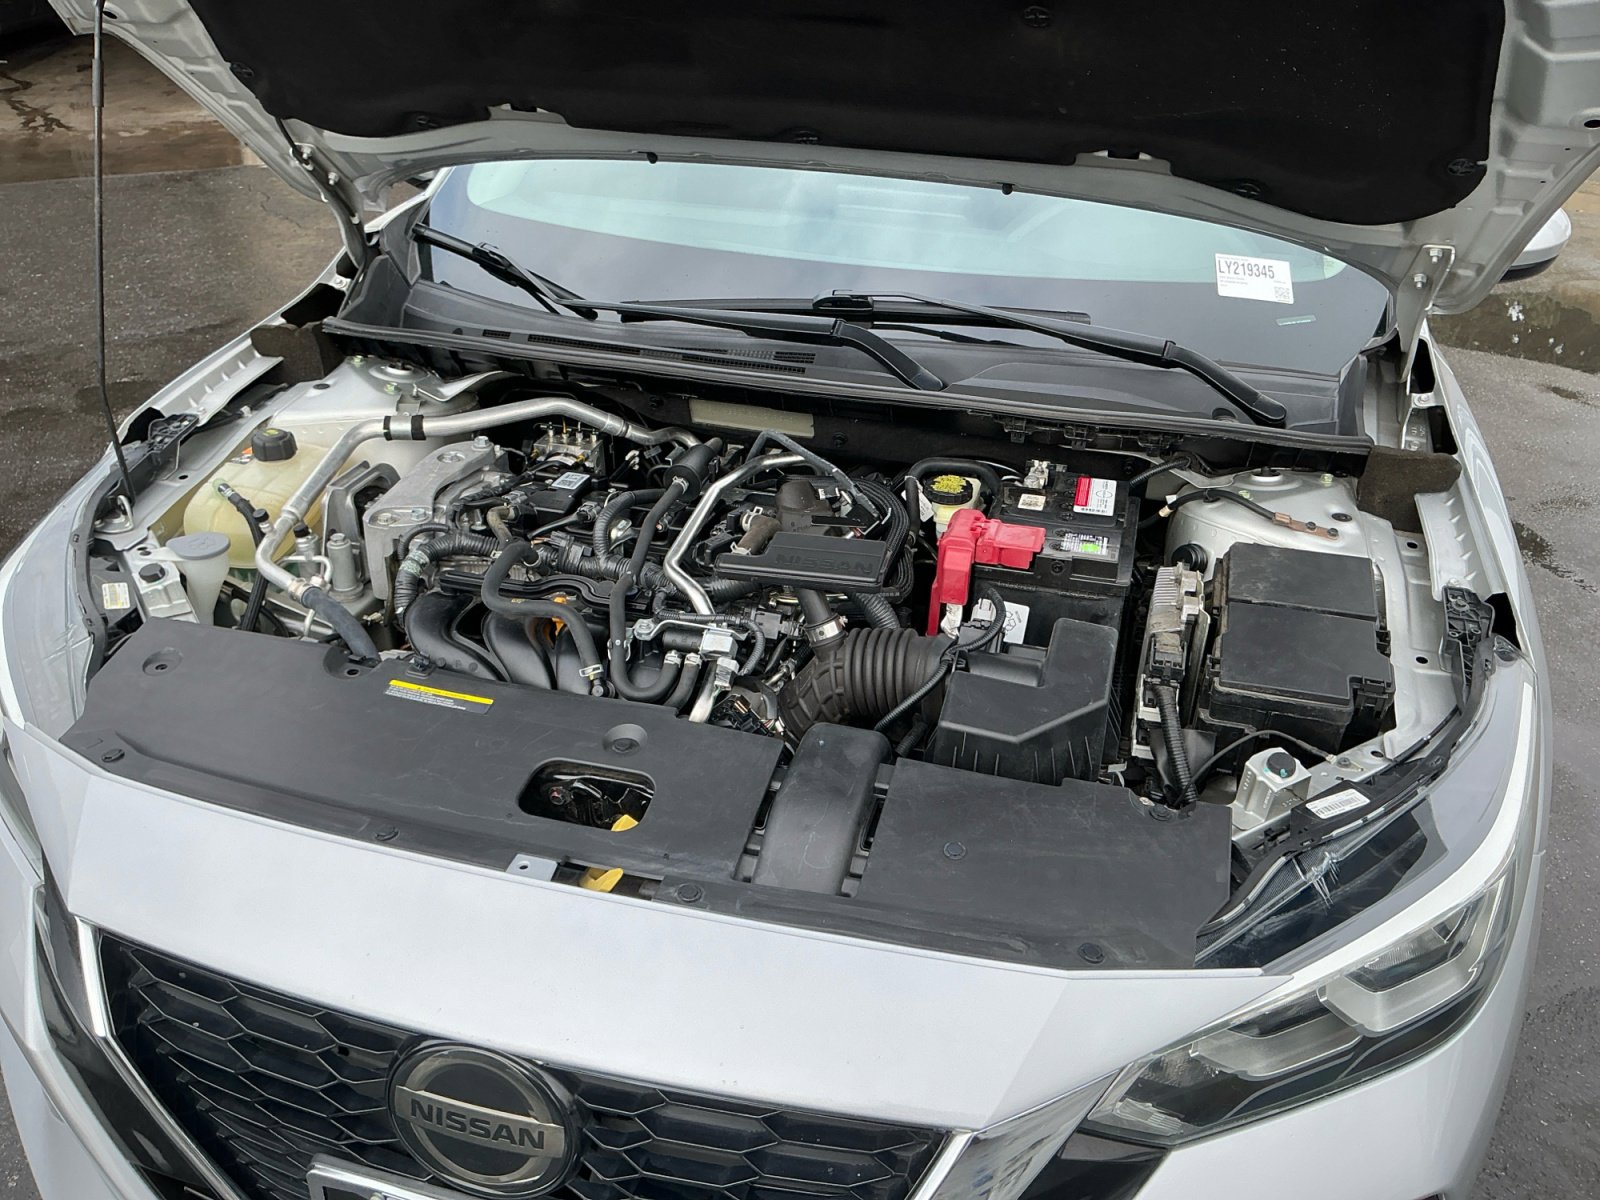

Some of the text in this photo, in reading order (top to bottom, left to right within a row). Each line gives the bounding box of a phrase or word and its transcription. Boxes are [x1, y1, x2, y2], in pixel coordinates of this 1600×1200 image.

[1218, 259, 1275, 279] LY219345
[775, 553, 874, 574] NISSAN
[410, 1098, 545, 1150] NISSAN
